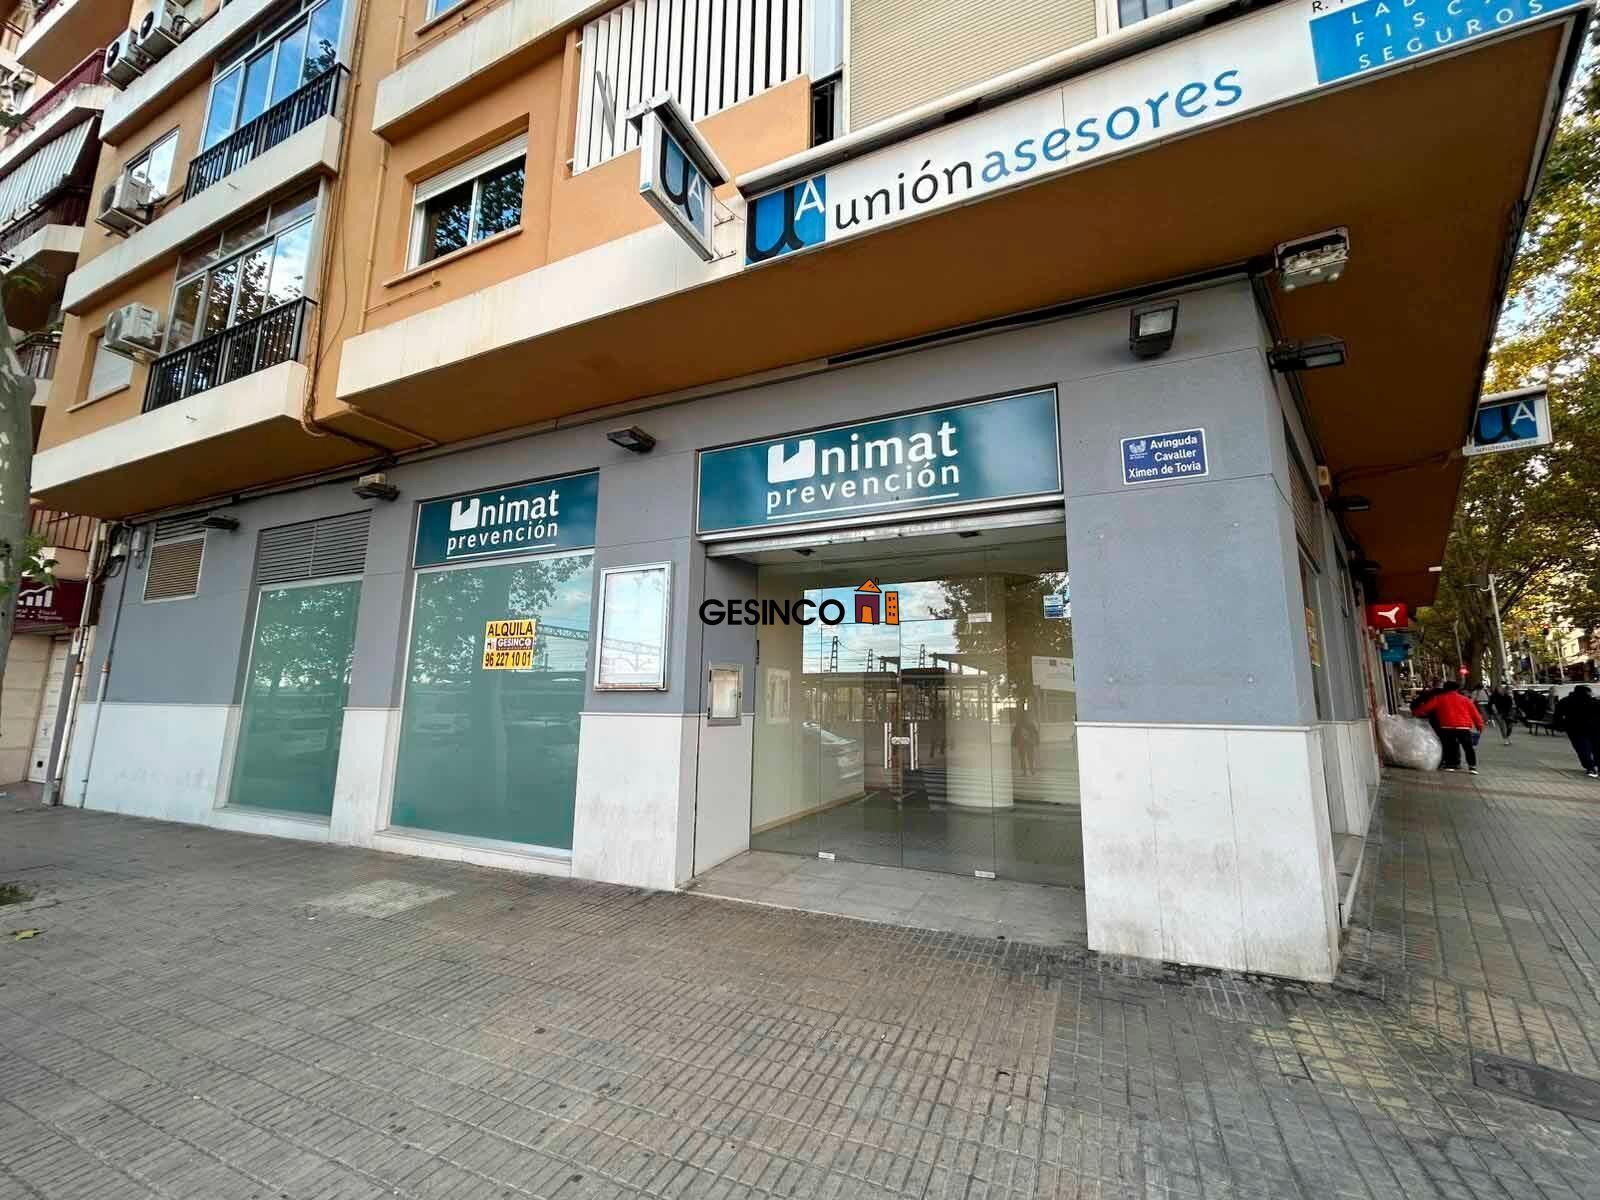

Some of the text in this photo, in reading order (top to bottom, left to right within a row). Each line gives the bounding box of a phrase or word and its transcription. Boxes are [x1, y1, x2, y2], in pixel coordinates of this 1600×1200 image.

[1359, 0, 1543, 69] SEGUROS
[1150, 435, 1198, 450] Avinguda
[1154, 449, 1197, 462] Cavaller
[1128, 466, 1159, 479] Ximen
[1161, 464, 1173, 474] de
[767, 462, 960, 514] prevención
[446, 519, 559, 556] prevención
[487, 621, 534, 637] ALQUILA
[497, 637, 532, 648] GESINCO
[485, 651, 531, 667] 96 227 10 01
